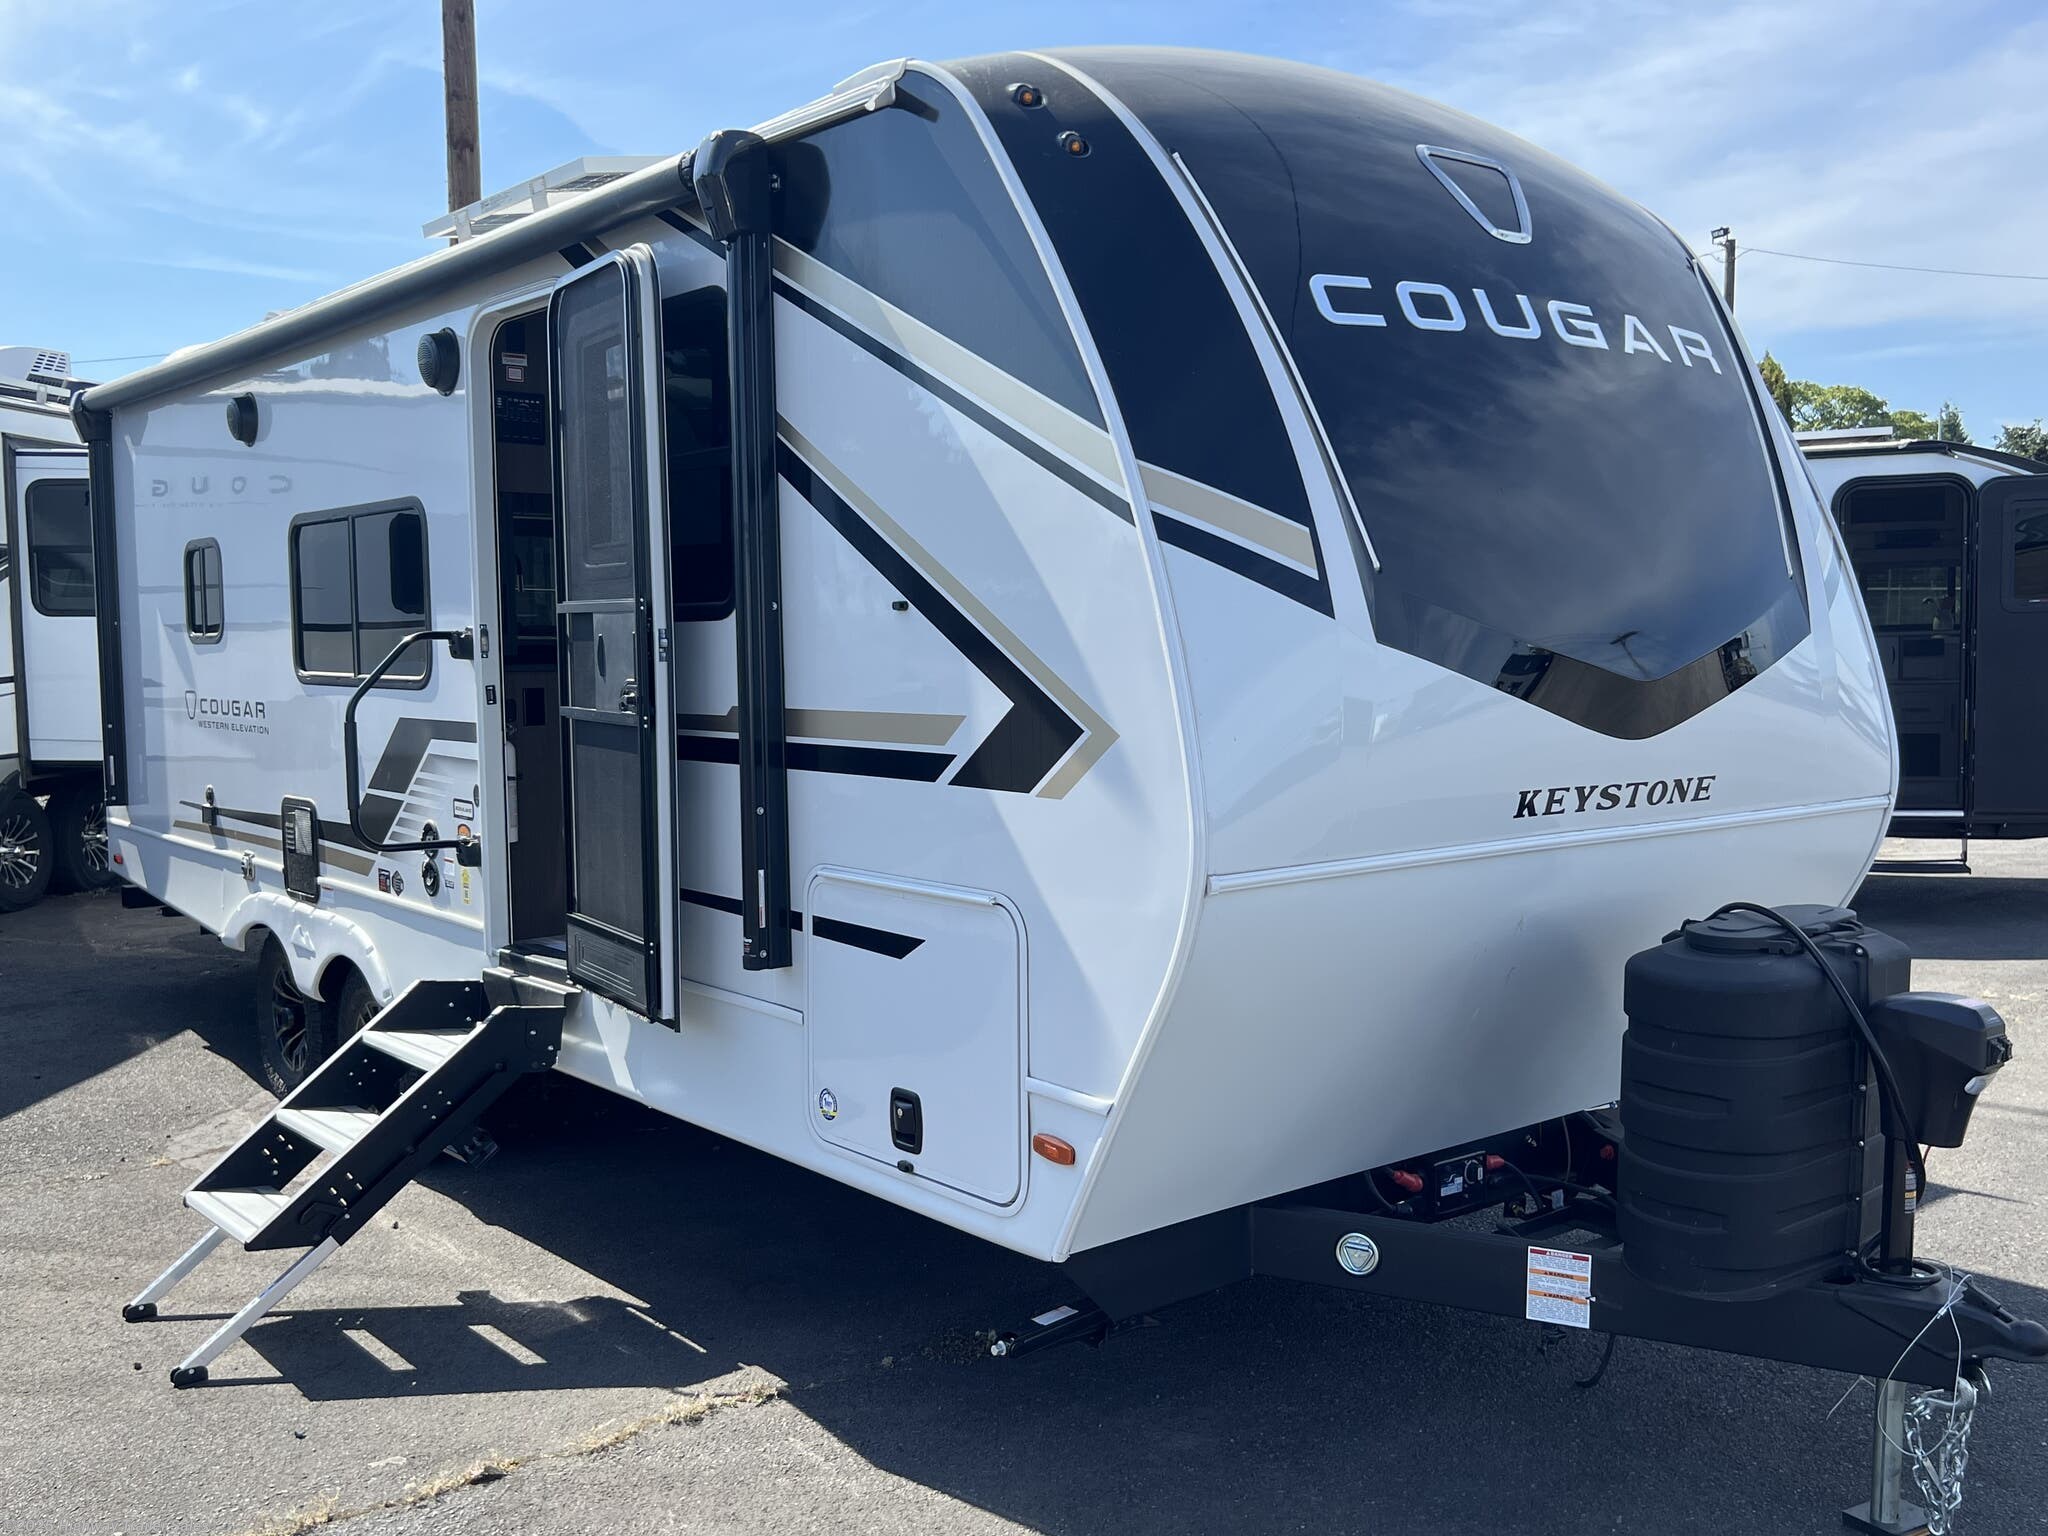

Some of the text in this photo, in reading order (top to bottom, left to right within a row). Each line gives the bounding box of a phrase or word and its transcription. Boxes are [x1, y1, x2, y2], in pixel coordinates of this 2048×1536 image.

[1308, 273, 1722, 375] COUGAR
[199, 698, 266, 719] COUGAR
[198, 720, 270, 735] WESTERN ELEVATION
[1513, 775, 1716, 819] KEYSTONE
